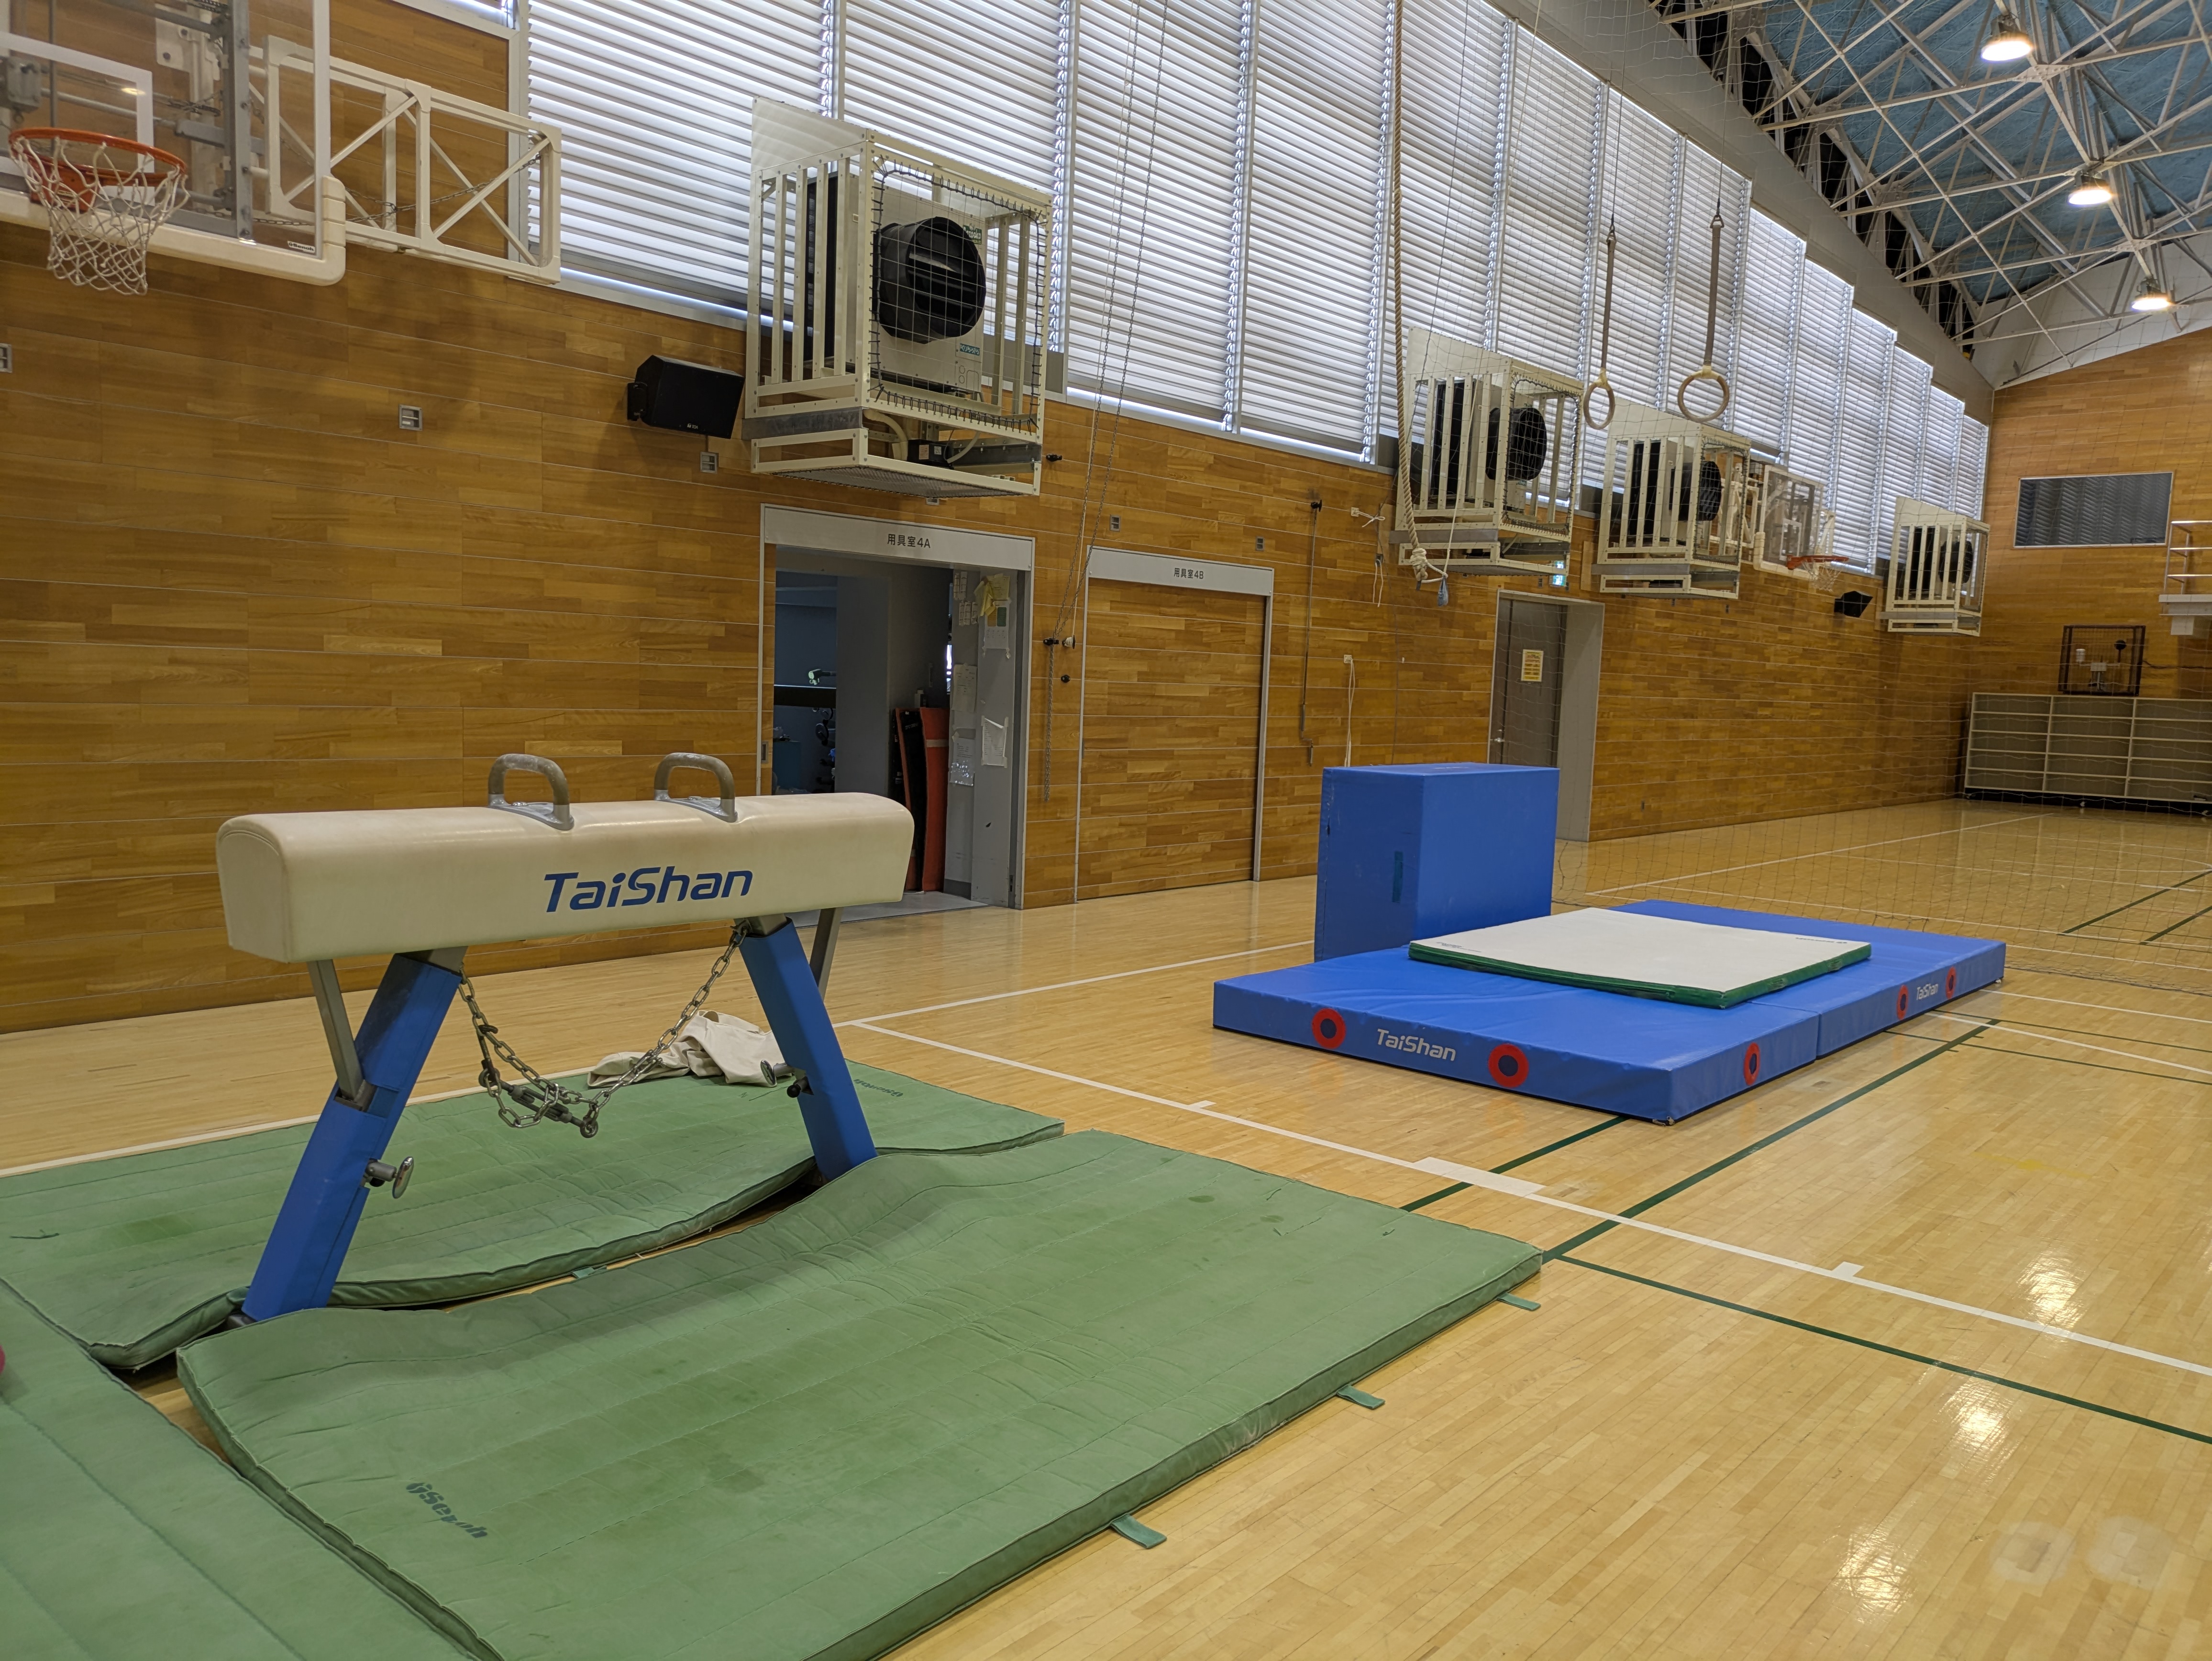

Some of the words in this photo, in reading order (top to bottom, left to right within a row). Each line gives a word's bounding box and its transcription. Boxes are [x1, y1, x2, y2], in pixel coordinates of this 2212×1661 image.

[887, 533, 930, 548] 用具室4A
[1173, 567, 1204, 579] 用具室4B
[543, 866, 753, 913] TaiShan
[1377, 1029, 1456, 1061] TaiShan
